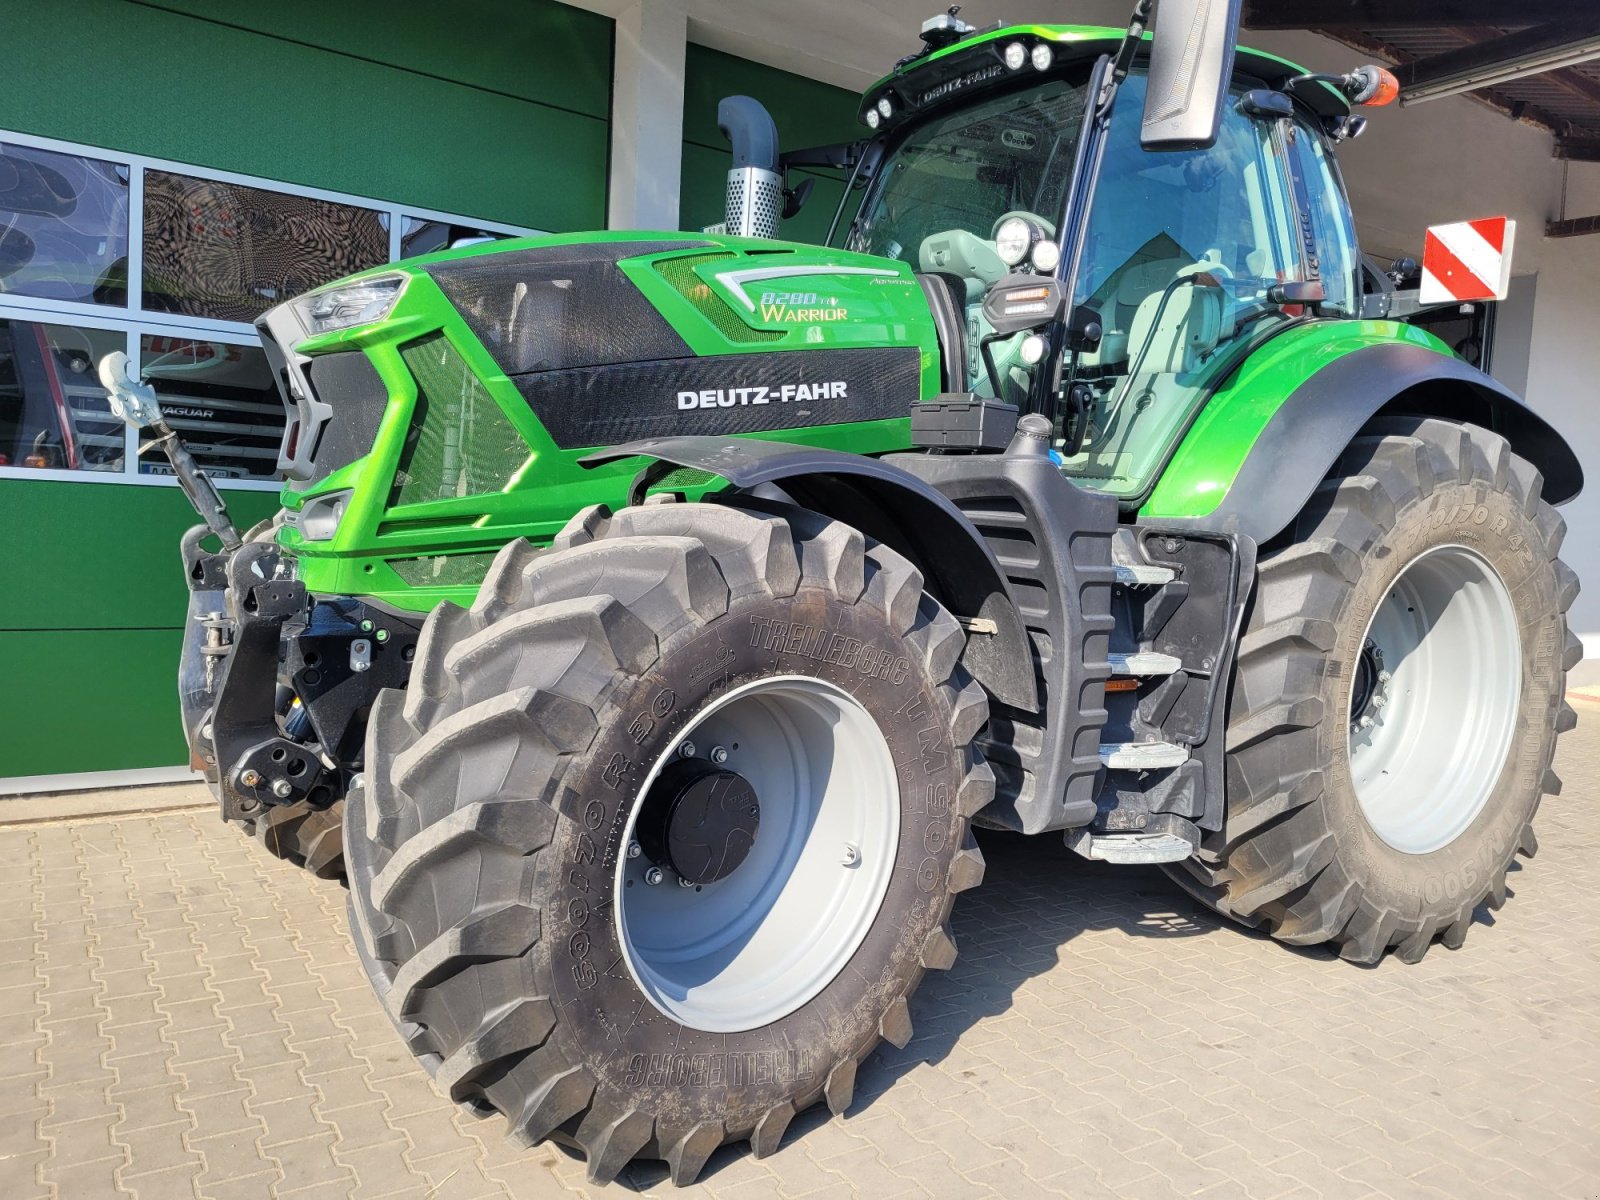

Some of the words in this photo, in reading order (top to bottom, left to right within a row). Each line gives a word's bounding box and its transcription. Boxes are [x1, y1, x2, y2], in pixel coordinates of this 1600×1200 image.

[923, 65, 1003, 103] DEUTZ-FAHR
[760, 292, 817, 305] 8280
[760, 304, 848, 322] WARRIOR
[160, 406, 214, 418] JAGUAR
[677, 381, 848, 410] DEUTZ-FAHR
[1488, 514, 1508, 537] R
[1507, 533, 1533, 569] 42
[750, 614, 910, 685] TRELLEBORG
[602, 752, 631, 790] R
[627, 687, 676, 745] 30
[906, 689, 949, 776] TM
[916, 782, 949, 894] 900
[1478, 808, 1522, 870] TM
[1423, 859, 1478, 905] 900
[624, 1049, 816, 1089] TRELLEBORG
